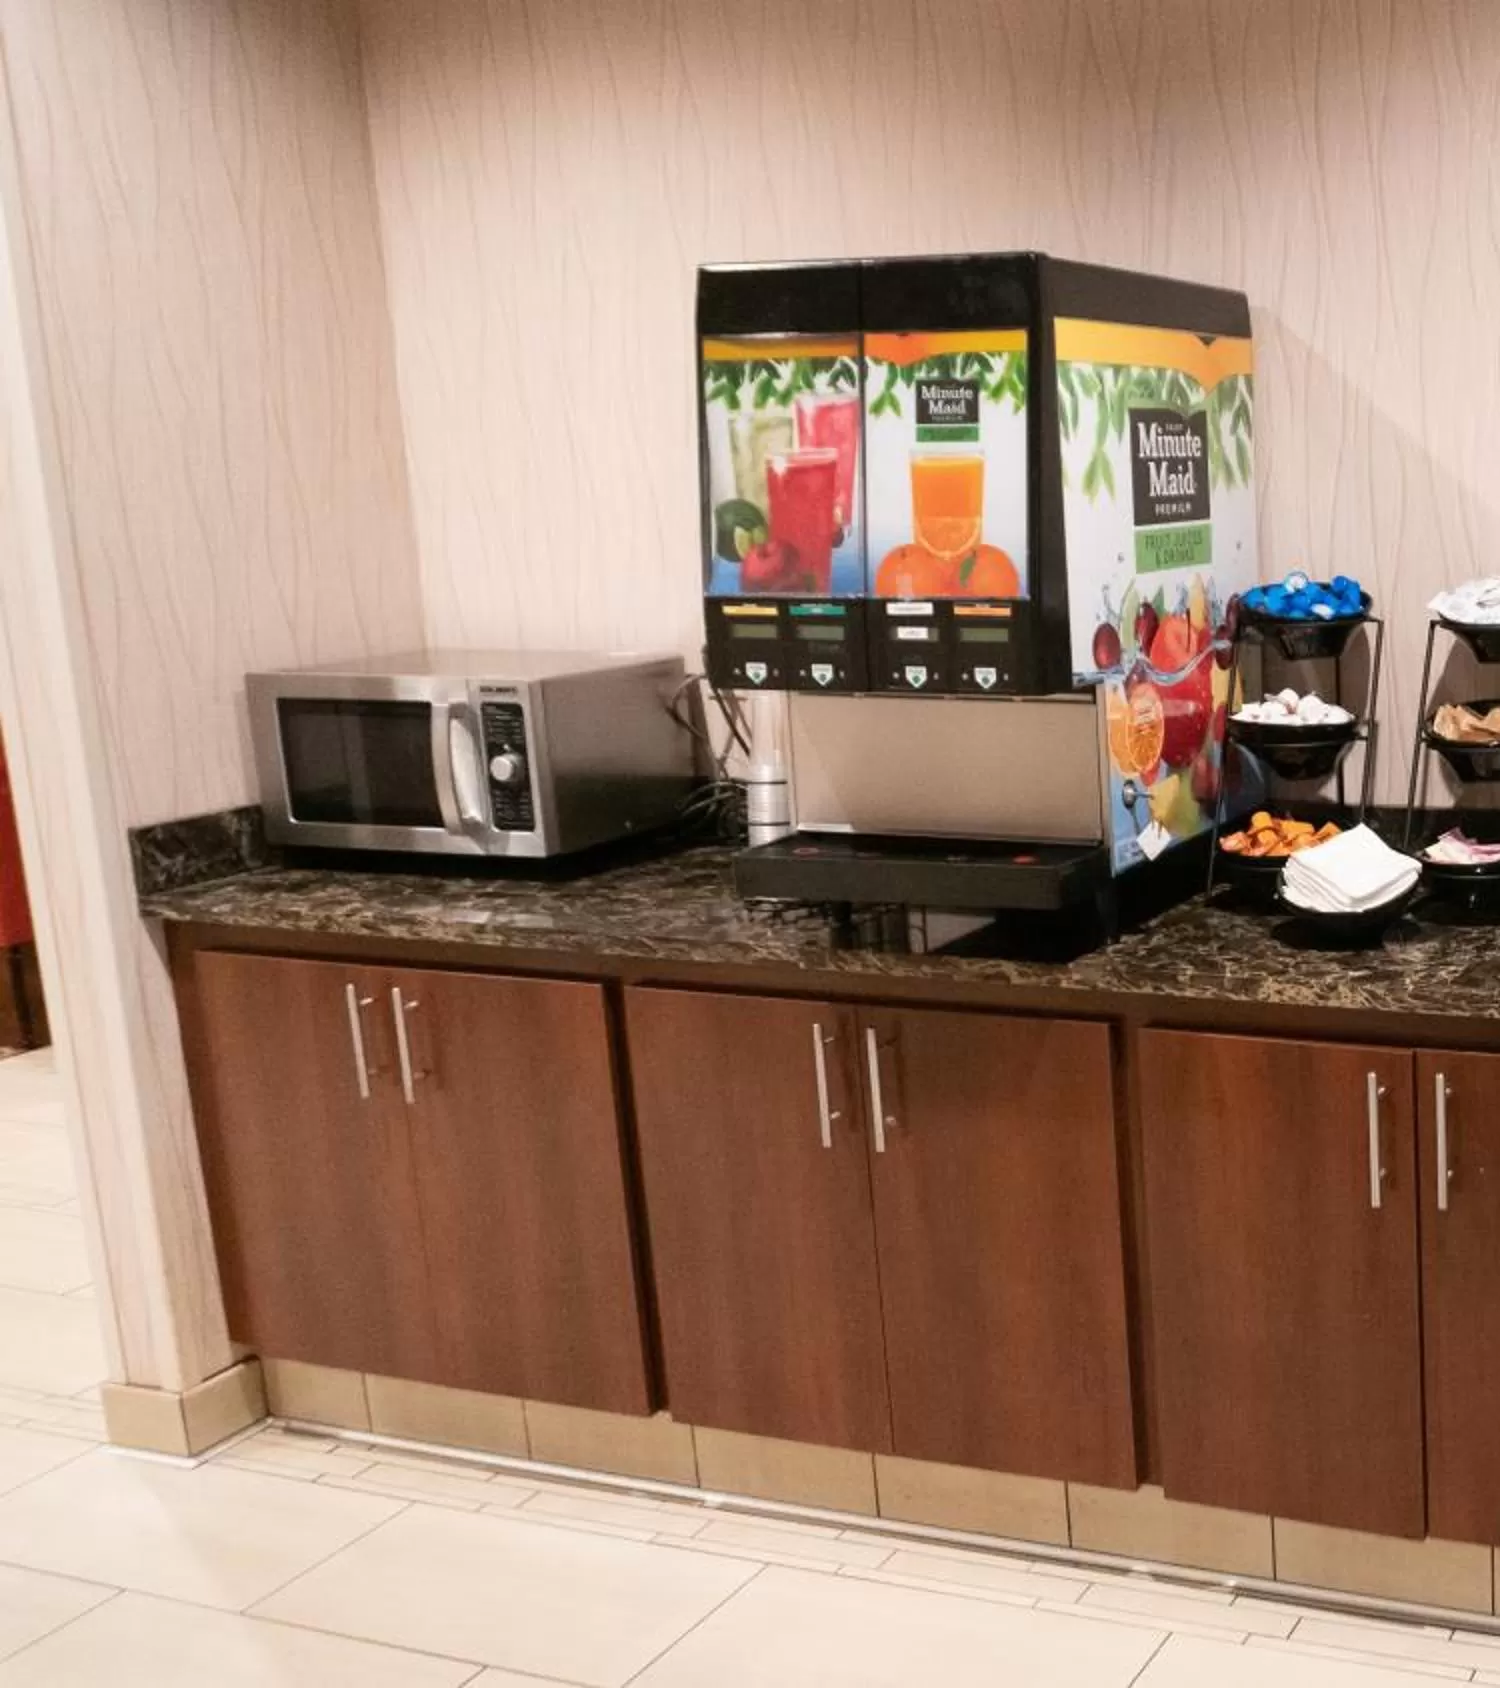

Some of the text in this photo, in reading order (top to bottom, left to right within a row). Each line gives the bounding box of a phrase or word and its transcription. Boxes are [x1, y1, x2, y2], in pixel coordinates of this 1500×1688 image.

[921, 384, 974, 400] Minute
[929, 399, 966, 415] Maid
[1137, 421, 1202, 457] Minute
[1147, 461, 1195, 497] Maid
